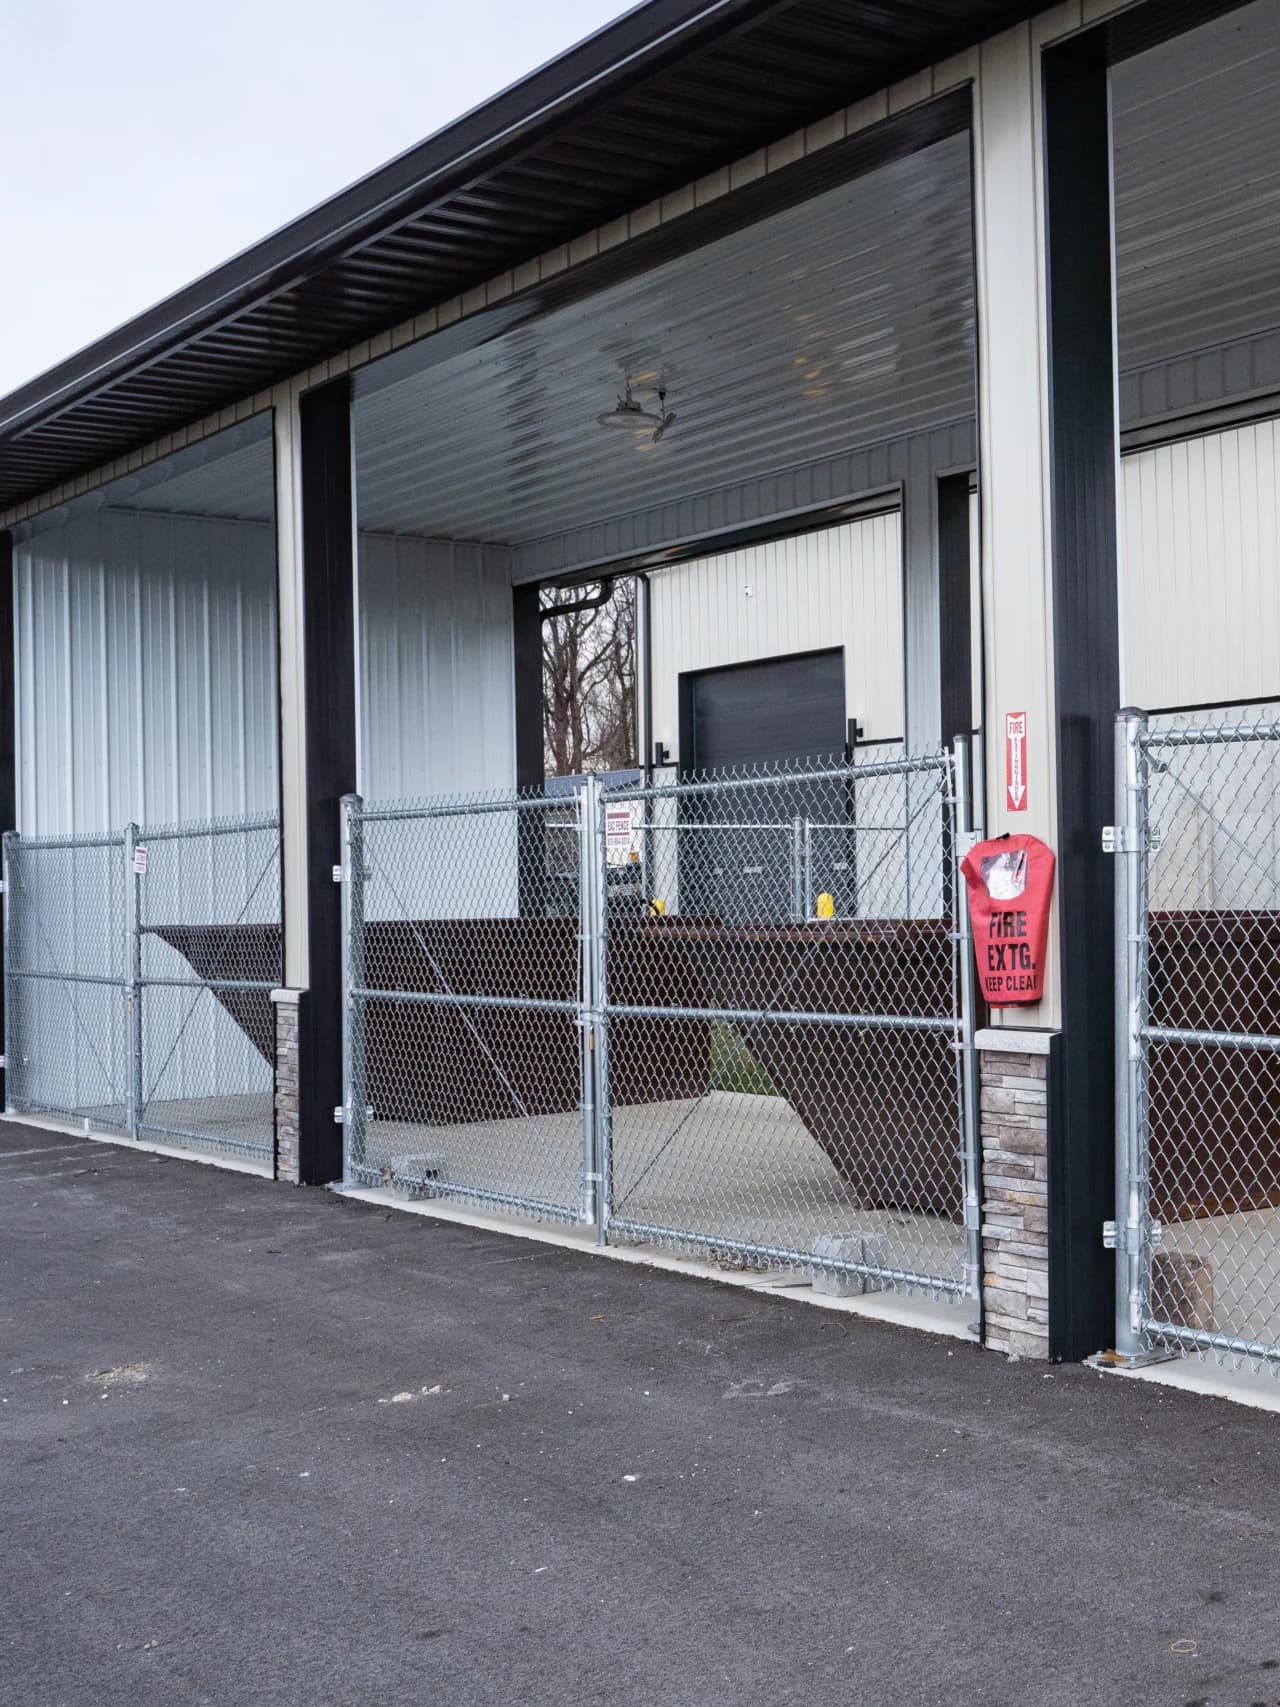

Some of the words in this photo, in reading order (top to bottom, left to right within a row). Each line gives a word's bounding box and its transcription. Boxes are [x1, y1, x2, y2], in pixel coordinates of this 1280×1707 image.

[1009, 721, 1023, 735] FIRE
[989, 911, 1027, 938] FIRE
[988, 942, 1037, 971] EXTG.
